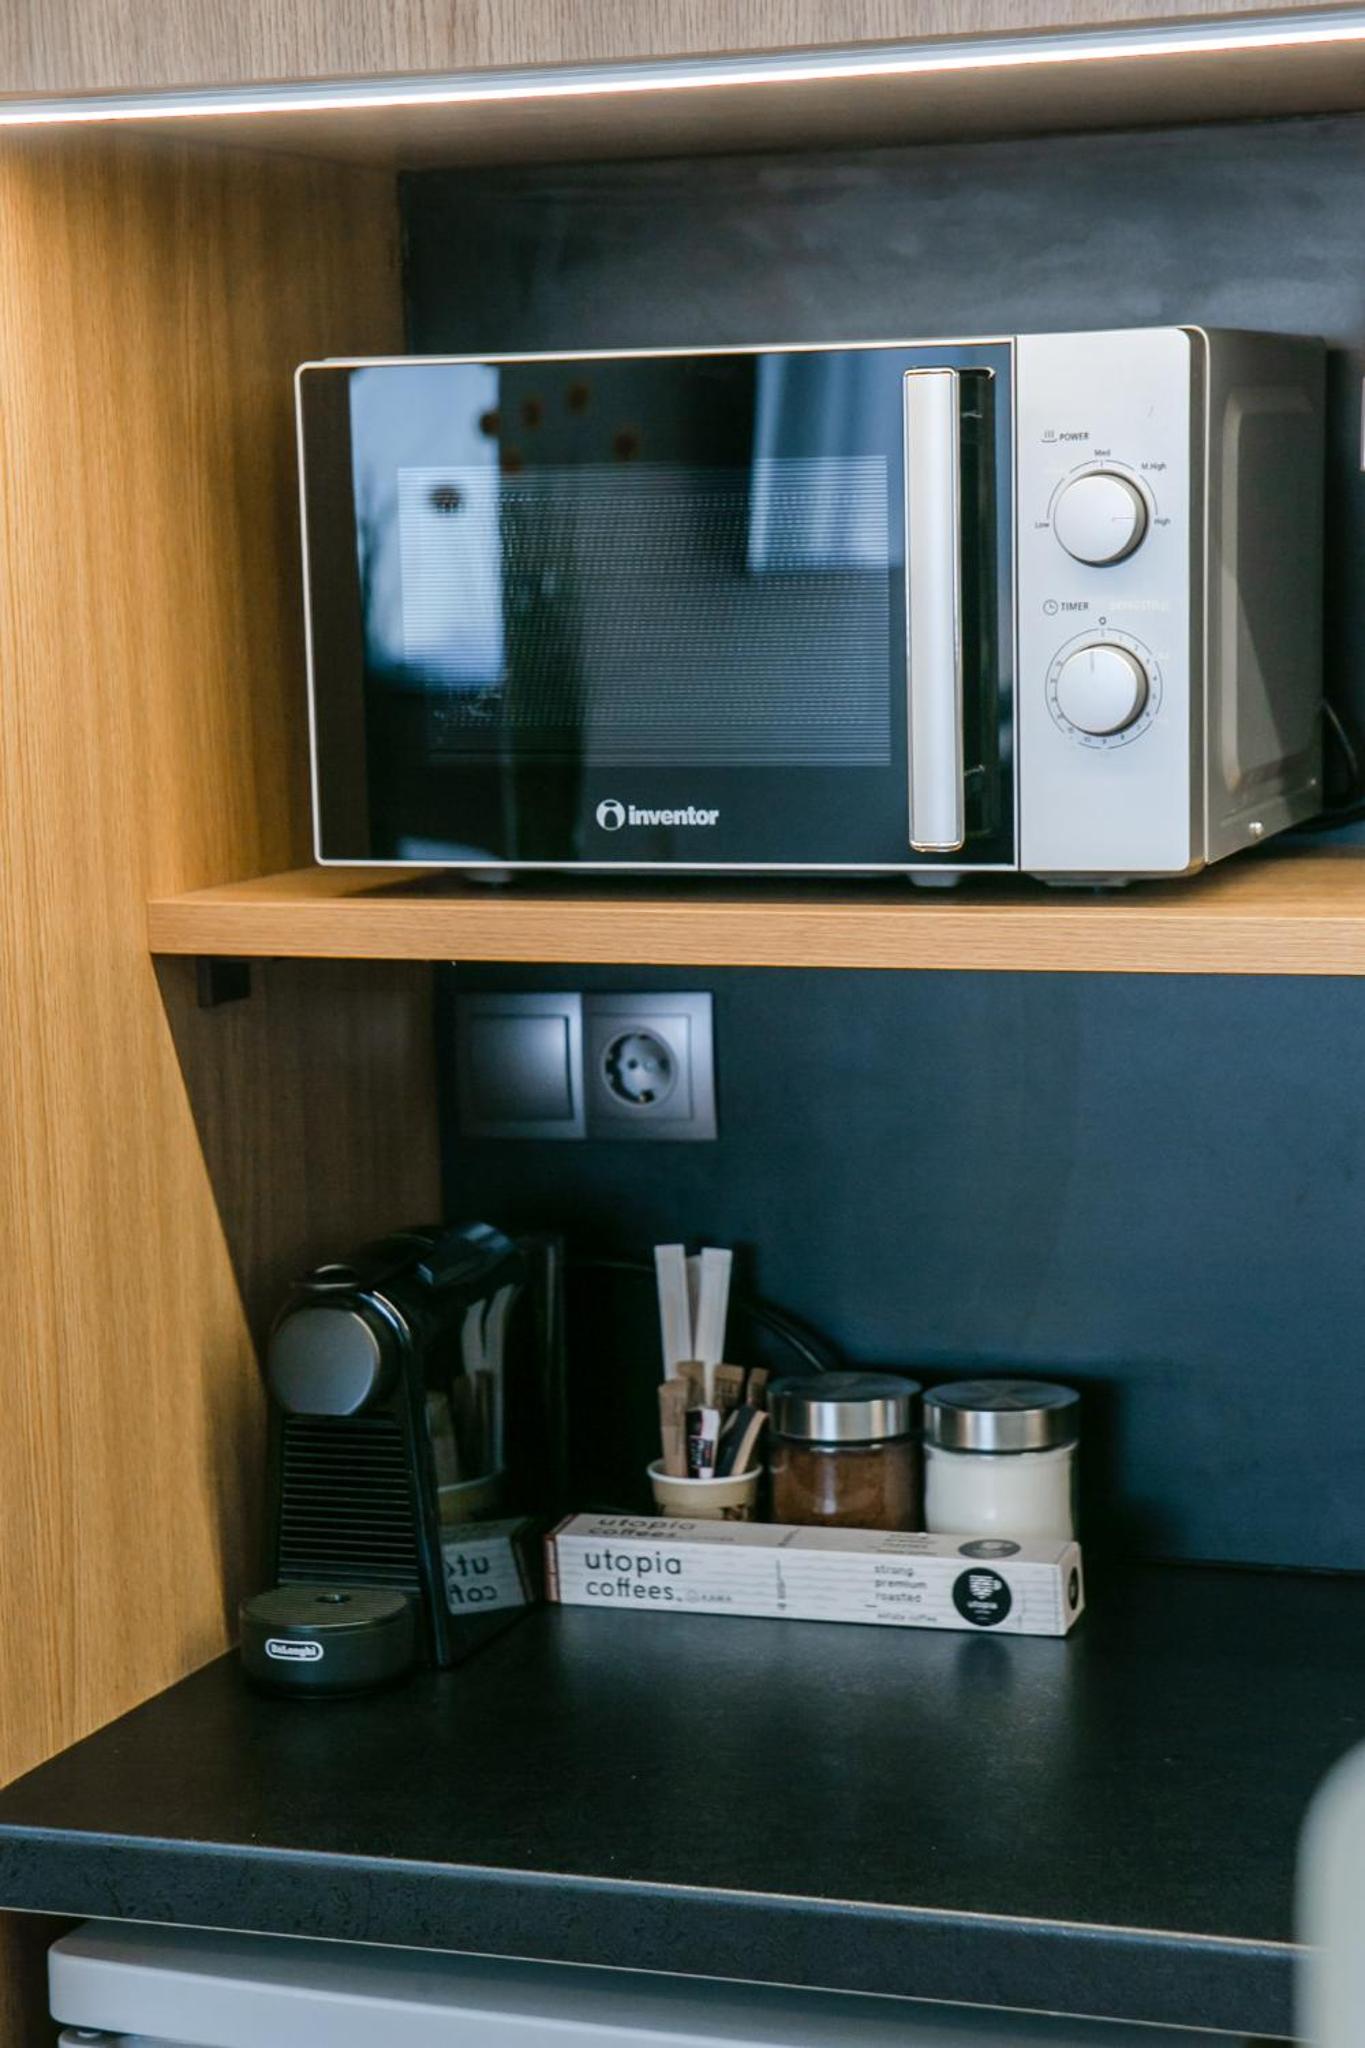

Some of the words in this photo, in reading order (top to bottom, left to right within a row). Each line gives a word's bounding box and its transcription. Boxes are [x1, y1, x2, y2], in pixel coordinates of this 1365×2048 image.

[1059, 432, 1089, 441] POWER
[1094, 449, 1111, 457] Med
[1035, 521, 1050, 529] Low
[1154, 518, 1171, 527] High
[1061, 602, 1089, 611] TIMER
[628, 805, 719, 825] inventor
[584, 1549, 682, 1578] utopia
